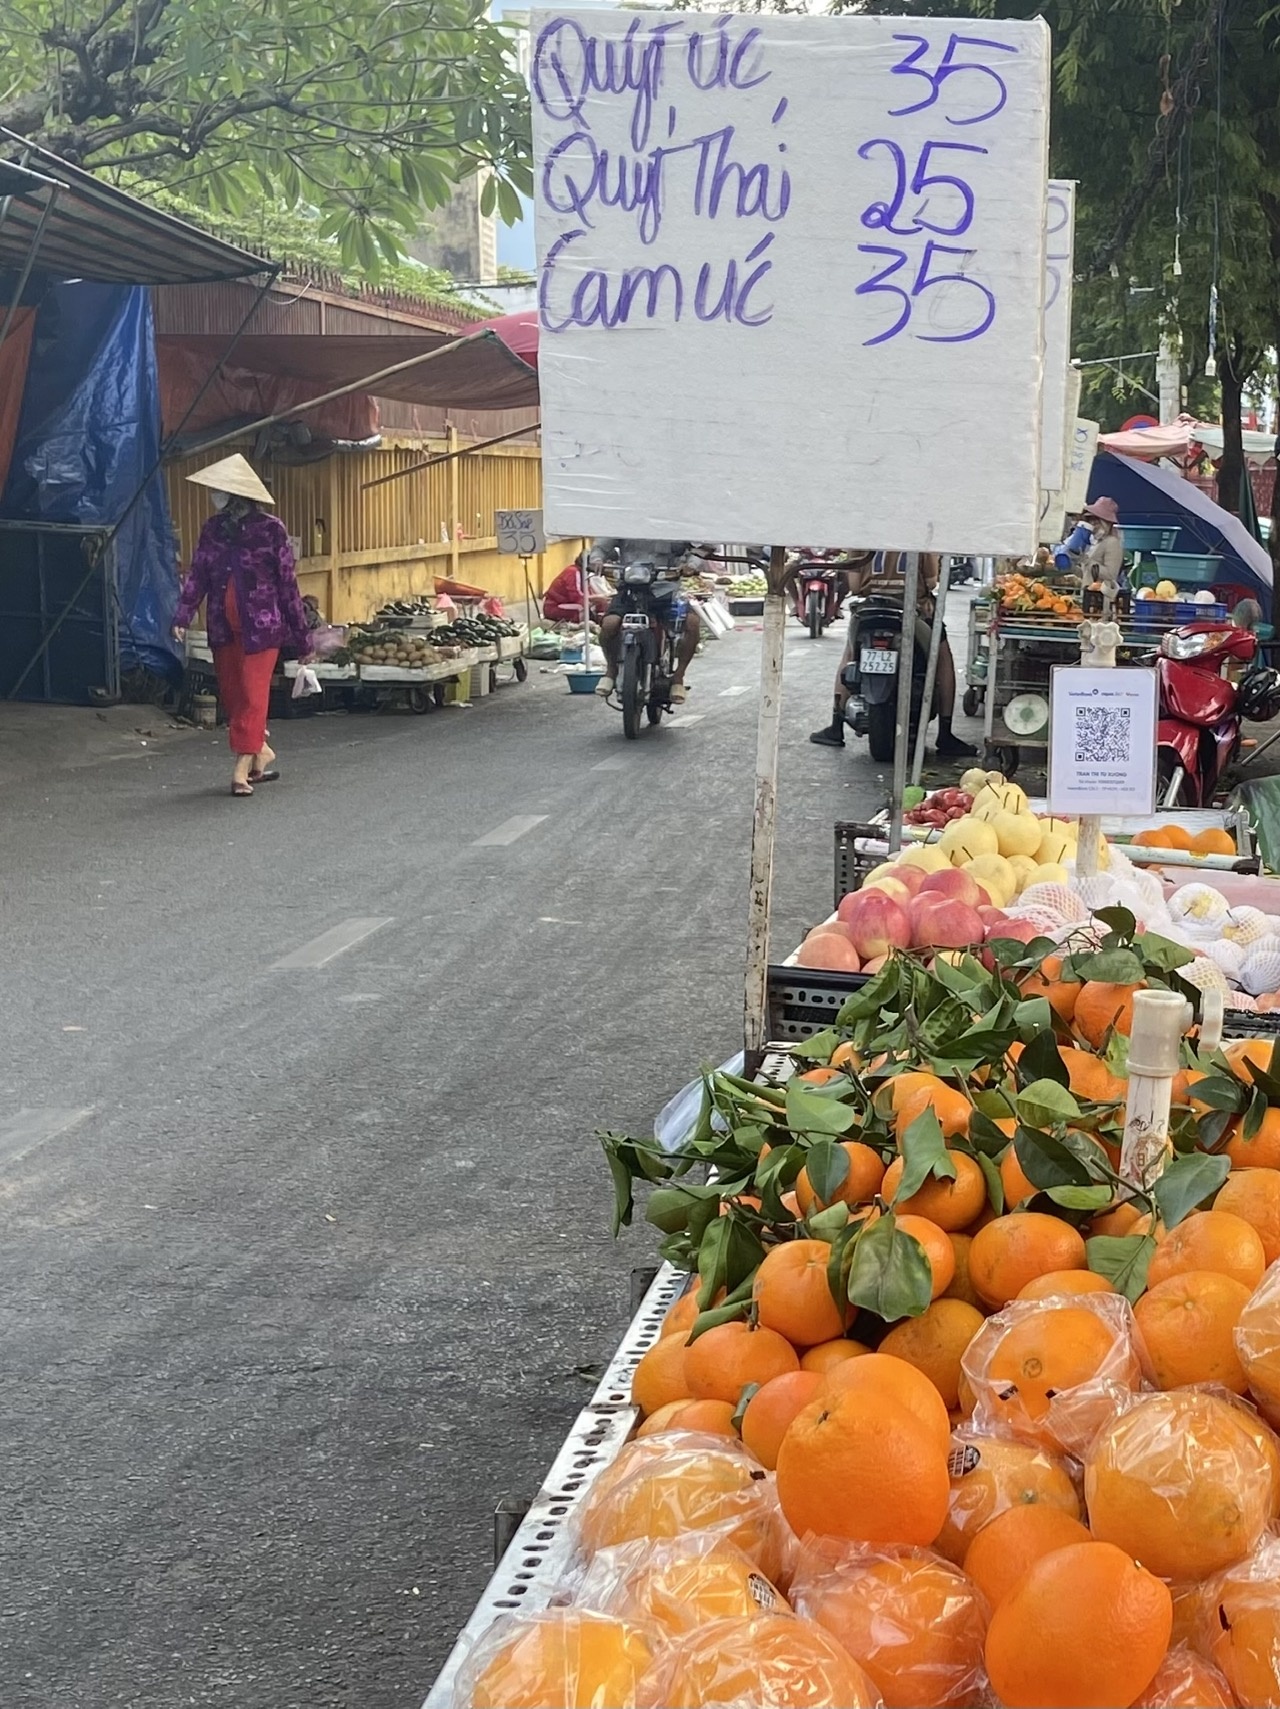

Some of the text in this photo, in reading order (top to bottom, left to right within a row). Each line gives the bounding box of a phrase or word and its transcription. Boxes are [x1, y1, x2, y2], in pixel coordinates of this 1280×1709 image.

[887, 33, 1019, 125] 35
[857, 138, 988, 236] 25
[539, 229, 683, 333] Cam
[855, 240, 996, 346] 35
[500, 530, 537, 553] 35
